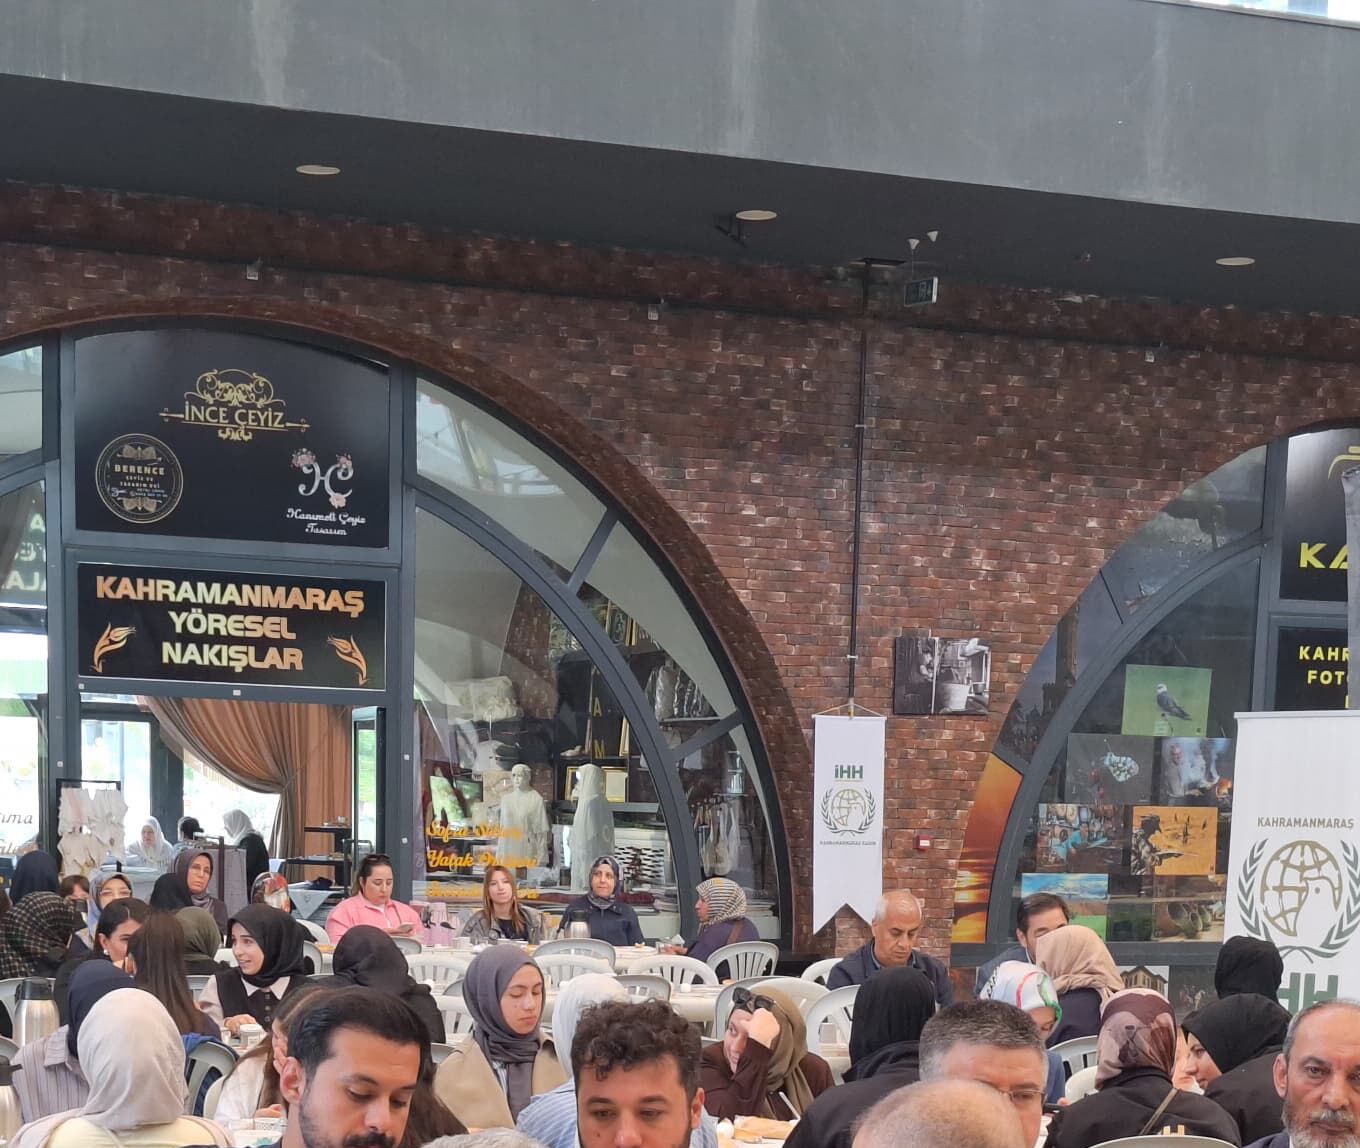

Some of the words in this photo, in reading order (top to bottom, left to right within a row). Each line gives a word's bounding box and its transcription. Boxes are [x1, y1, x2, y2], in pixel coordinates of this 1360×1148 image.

[184, 401, 228, 424] İNCE
[234, 407, 284, 432] ÇEYİZ
[96, 576, 364, 618] KAHRAMANMARAŞ
[168, 609, 297, 640] YÖRESEL
[162, 642, 304, 672] NAKIŞLAR
[1299, 646, 1349, 661] KAHR
[1307, 670, 1348, 685] FOT
